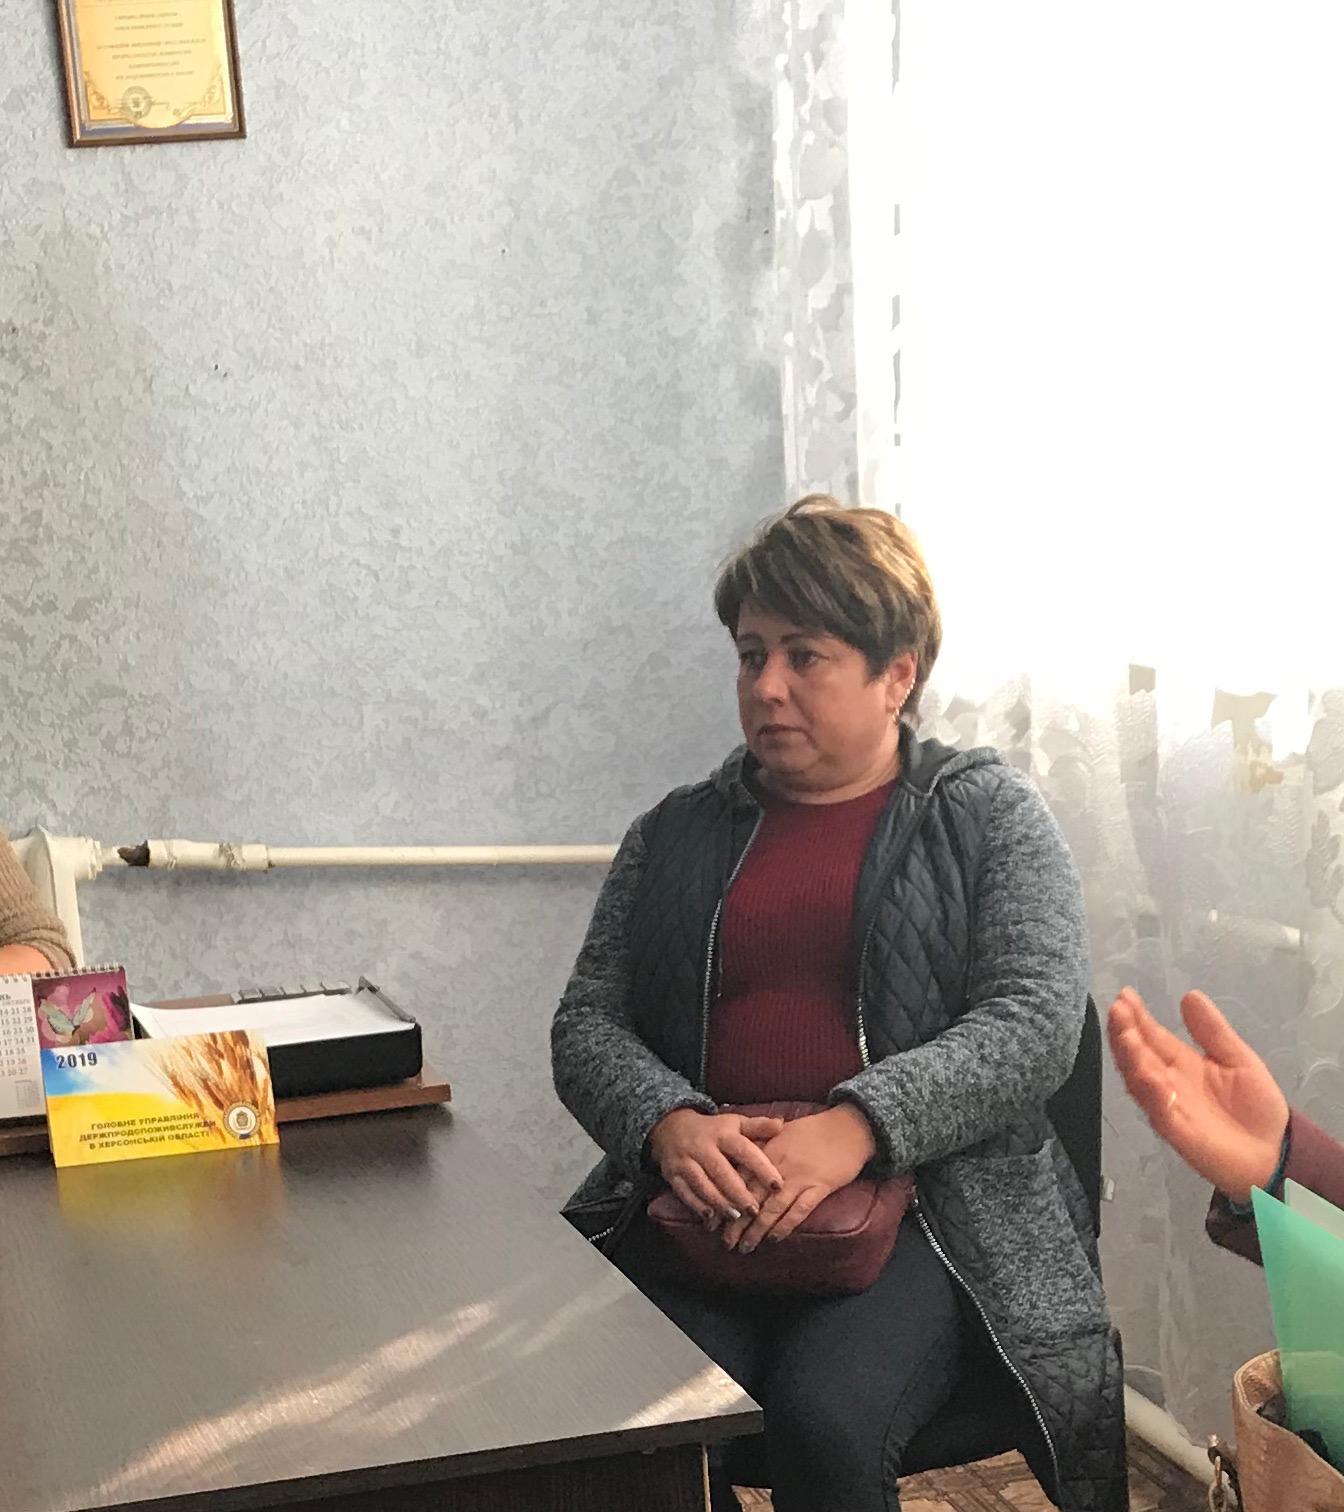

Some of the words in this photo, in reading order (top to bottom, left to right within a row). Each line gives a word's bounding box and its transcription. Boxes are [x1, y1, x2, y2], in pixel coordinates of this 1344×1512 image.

[0, 1008, 8, 1016] 14
[11, 1007, 20, 1015] 21
[22, 1006, 32, 1014] 28
[56, 1051, 98, 1069] 2019
[91, 1119, 137, 1130] ГОЛОВНЕ
[138, 1112, 200, 1126] УПРАВЛІННЯ
[79, 1120, 217, 1142] ДЕРЖПРОДСПОЖИВСЛУЖБИ
[98, 1135, 166, 1149] ХЕРСОНСЬКІЙ
[167, 1130, 210, 1140] ОБЛАСТІ
